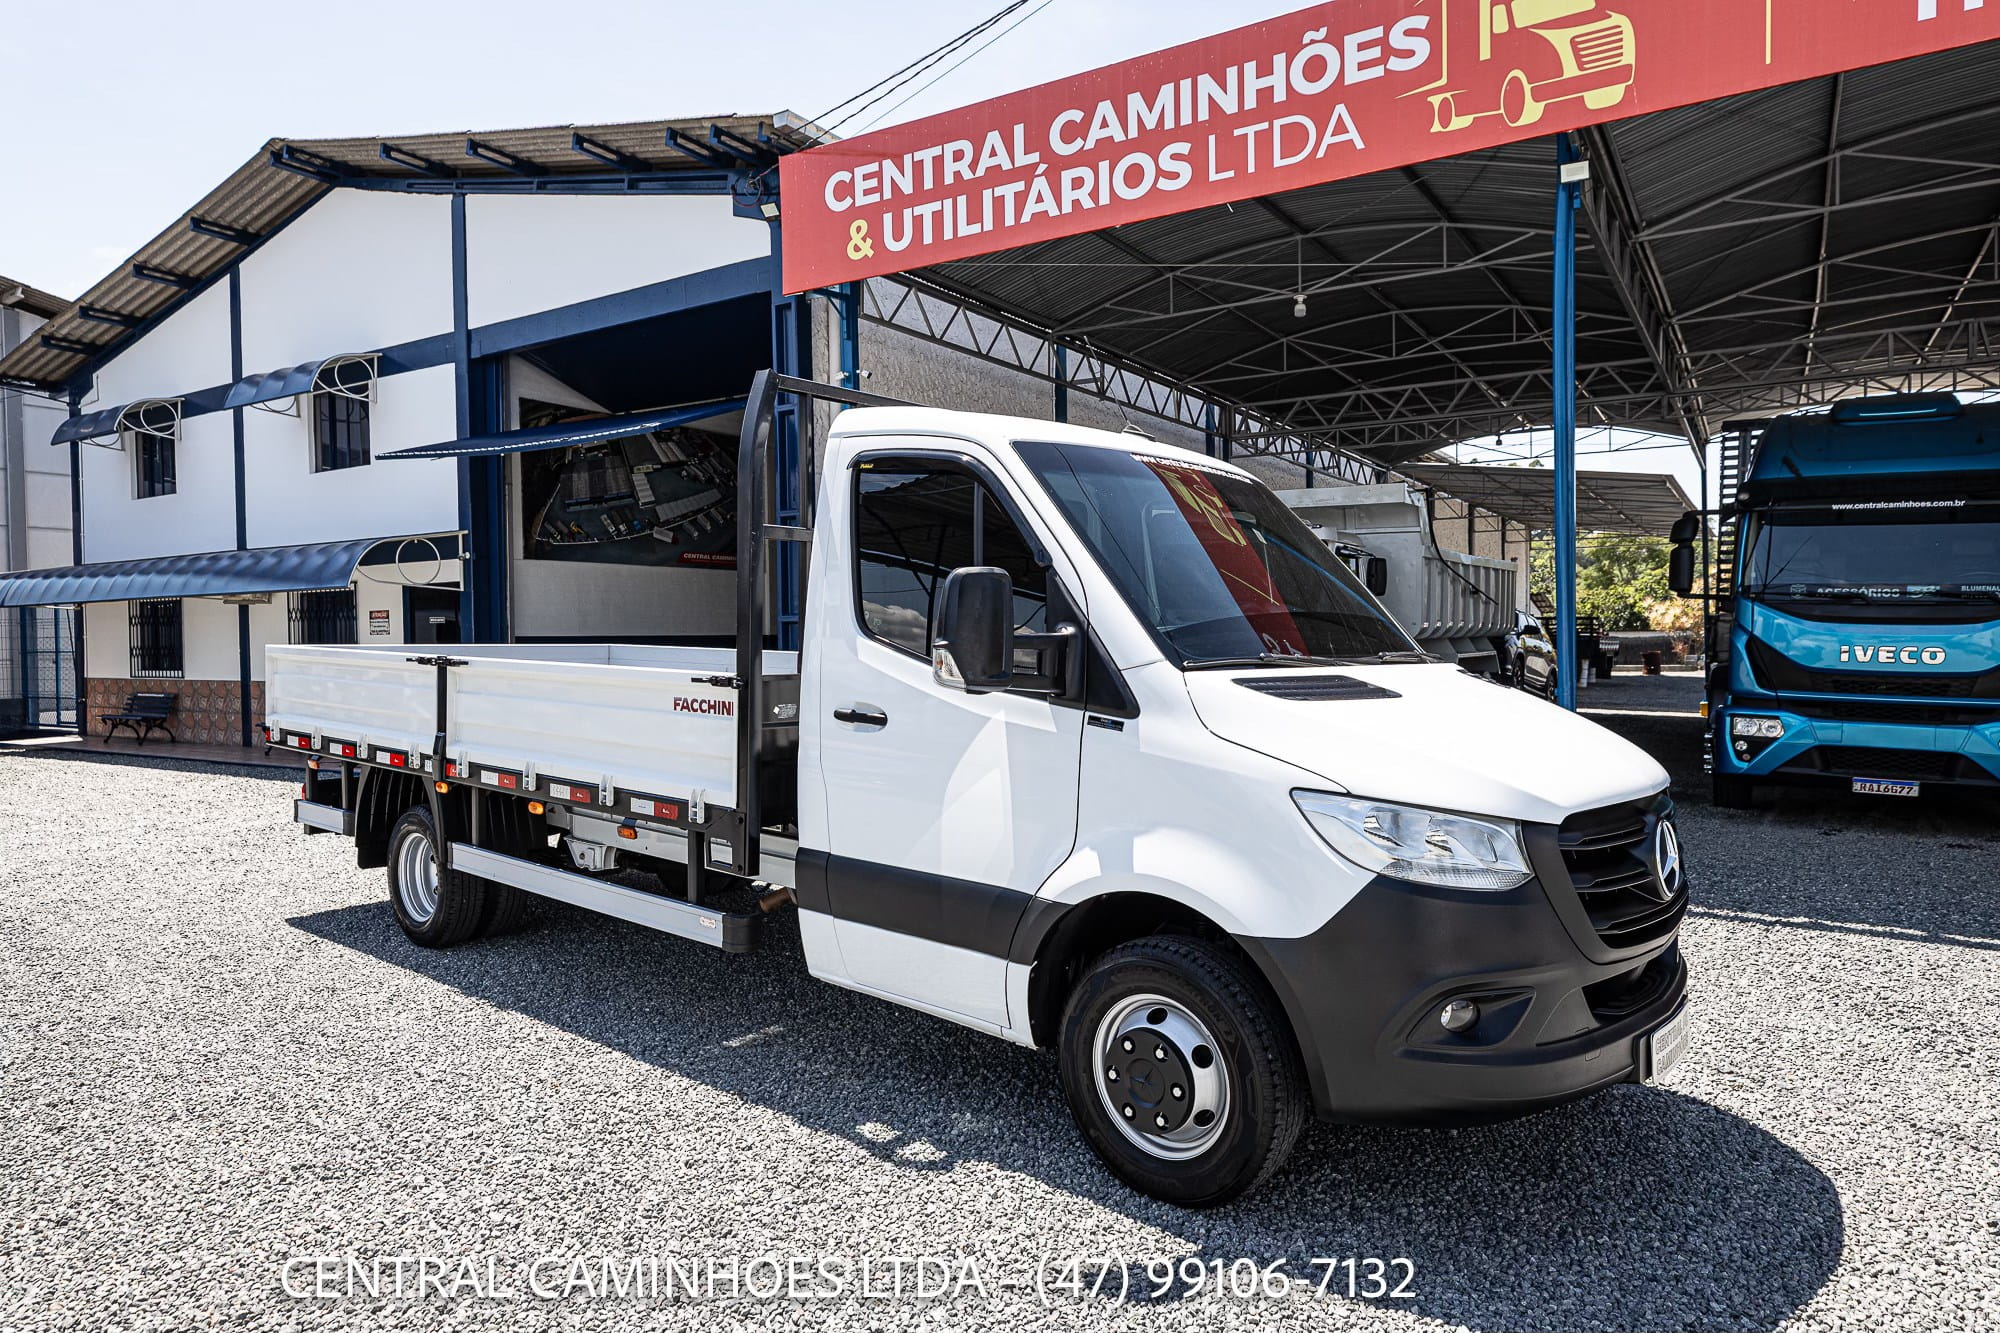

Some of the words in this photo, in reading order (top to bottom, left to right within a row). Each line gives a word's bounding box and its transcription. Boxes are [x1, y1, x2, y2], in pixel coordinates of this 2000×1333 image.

[824, 122, 1040, 213] CENTRAL
[1048, 15, 1431, 156] CAMINHÕES
[846, 218, 874, 260] &
[882, 141, 1193, 252] UTILITÁRIOS
[1208, 103, 1366, 183] LTDA
[1831, 499, 1966, 511] www.centralcaminhoes.com.br
[1839, 644, 1947, 666] IVECO
[673, 696, 734, 717] FACCHINI
[1859, 783, 1914, 794] RAI6G77
